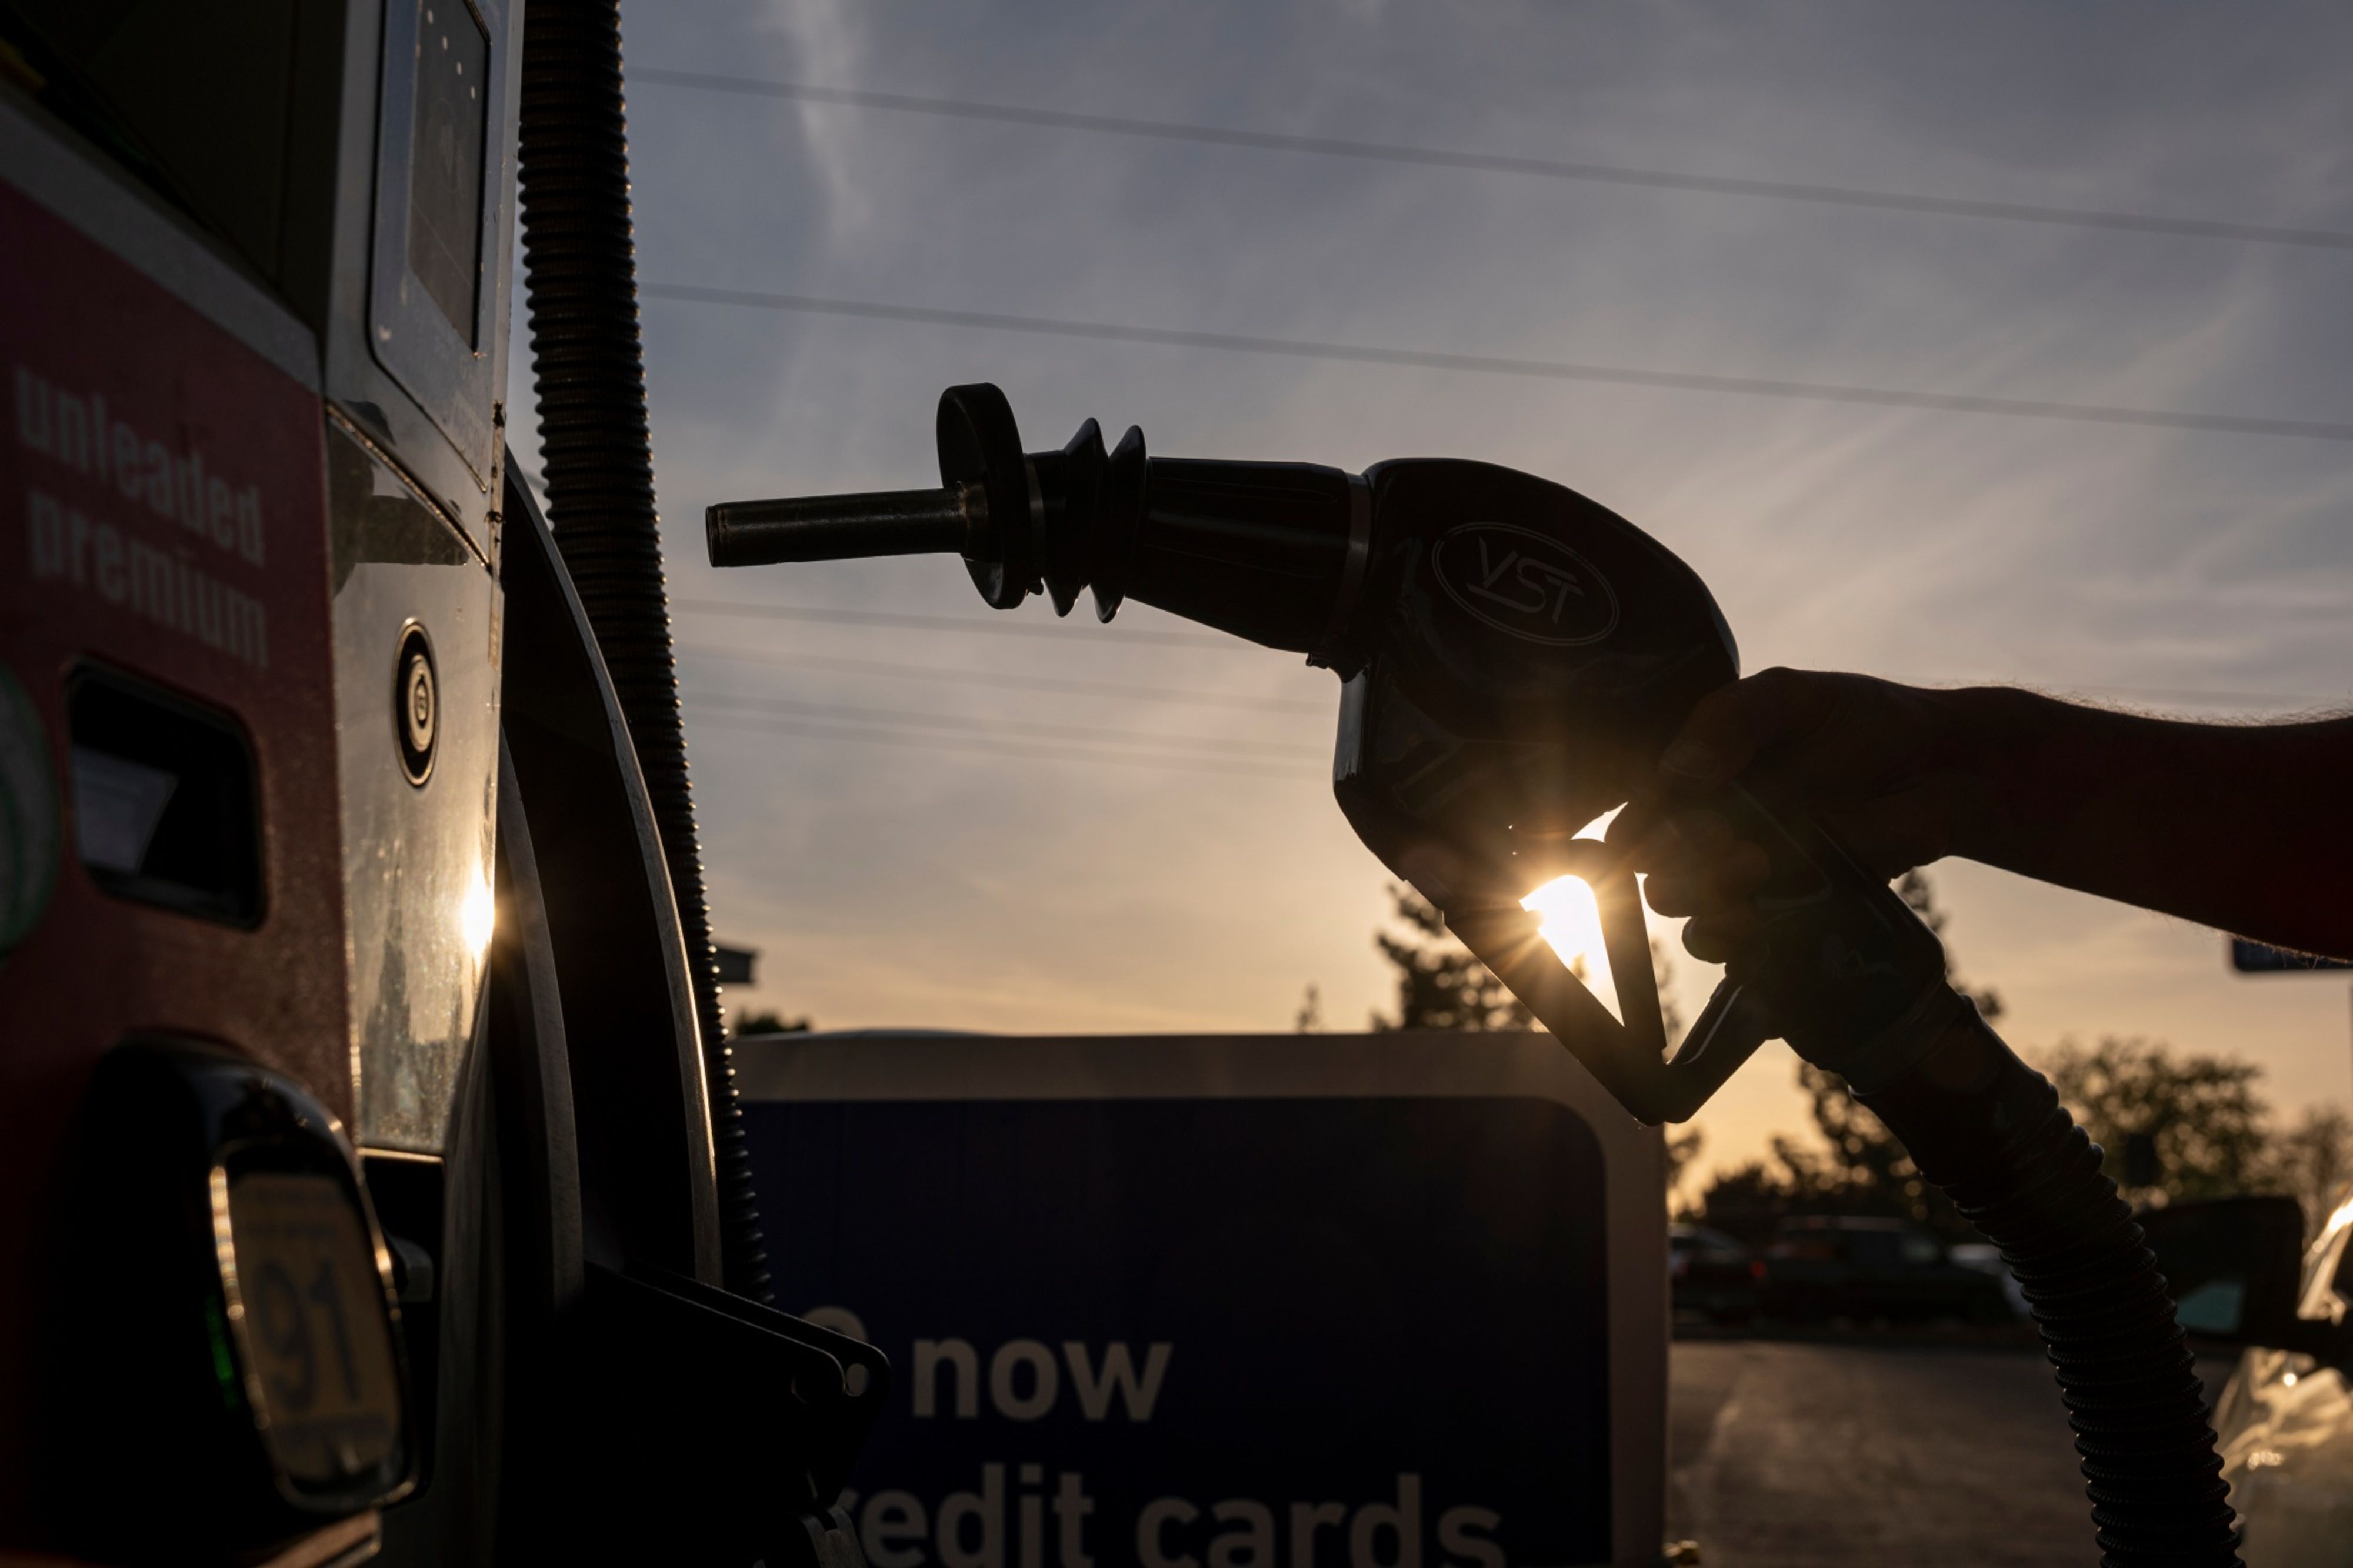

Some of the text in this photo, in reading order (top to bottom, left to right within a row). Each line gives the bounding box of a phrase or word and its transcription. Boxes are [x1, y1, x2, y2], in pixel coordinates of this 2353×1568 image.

[16, 366, 266, 568] unleaded
[28, 489, 268, 668] premium
[1466, 536, 1585, 624] VST
[255, 1260, 360, 1413] 91
[911, 1336, 1175, 1422] now
[1134, 1473, 1507, 1568] cards
